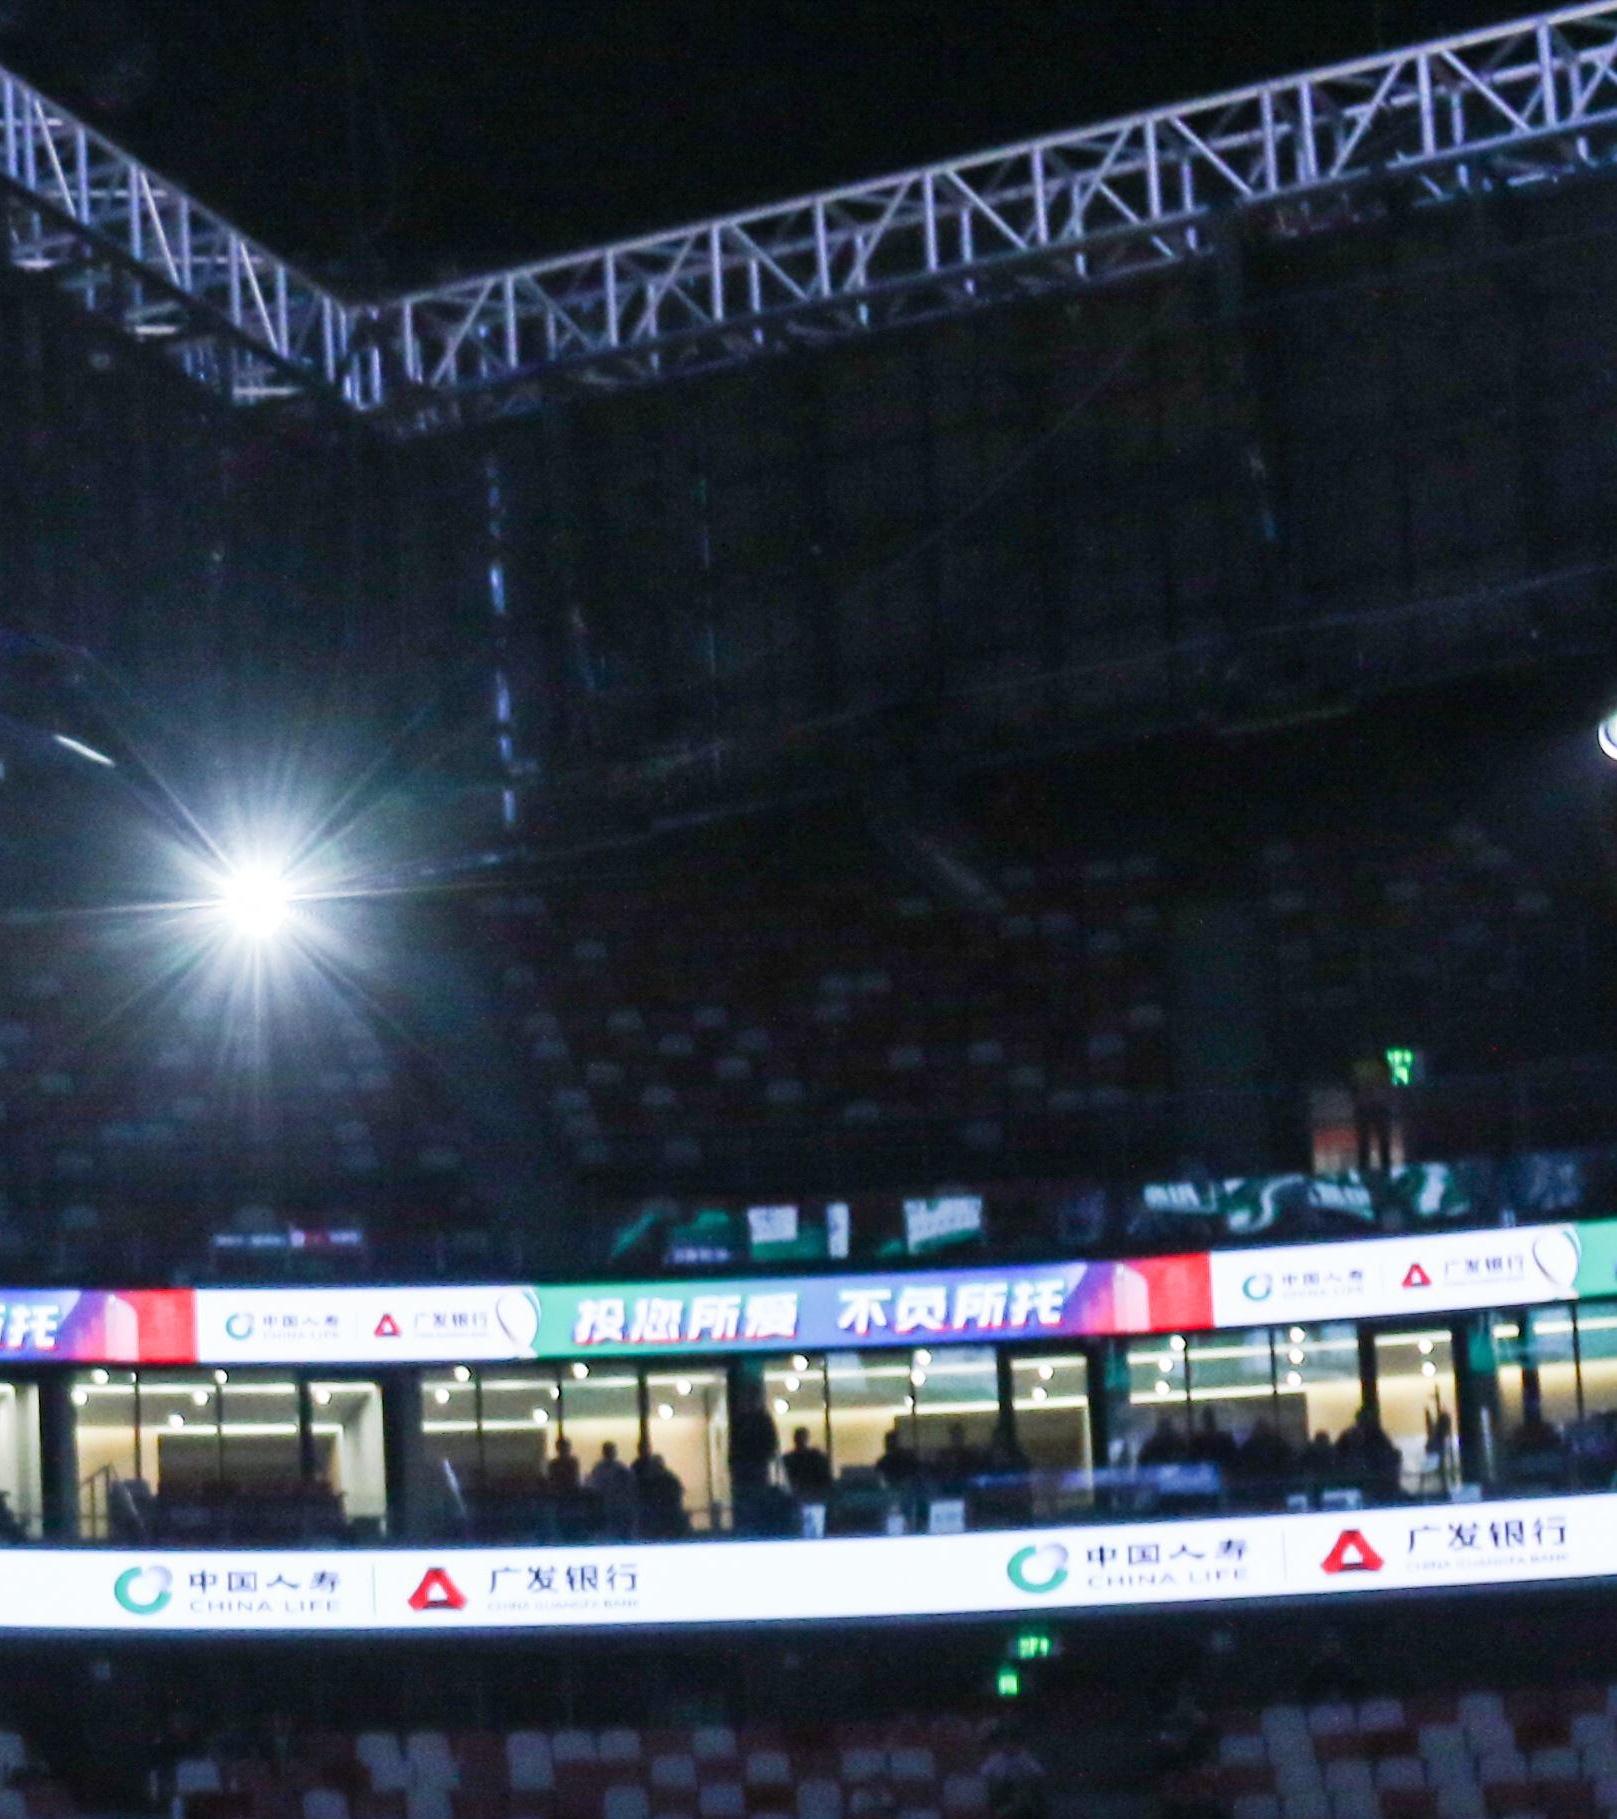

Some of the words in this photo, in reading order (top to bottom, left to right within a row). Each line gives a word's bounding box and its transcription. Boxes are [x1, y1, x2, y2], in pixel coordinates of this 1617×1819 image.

[1444, 1254, 1525, 1277] 广发银行
[574, 1292, 799, 1346] 投您所爱
[838, 1279, 1065, 1336] 不负所托
[1407, 1516, 1567, 1554] 广发银行
[1085, 1538, 1247, 1569] 中国人寿
[189, 1569, 341, 1595] 中国人寿
[488, 1564, 640, 1594] 广发银行
[1087, 1571, 1181, 1589] CHINA
[1189, 1567, 1247, 1584] LIFE
[189, 1601, 272, 1613] CHINA
[285, 1601, 340, 1613] LIFE
